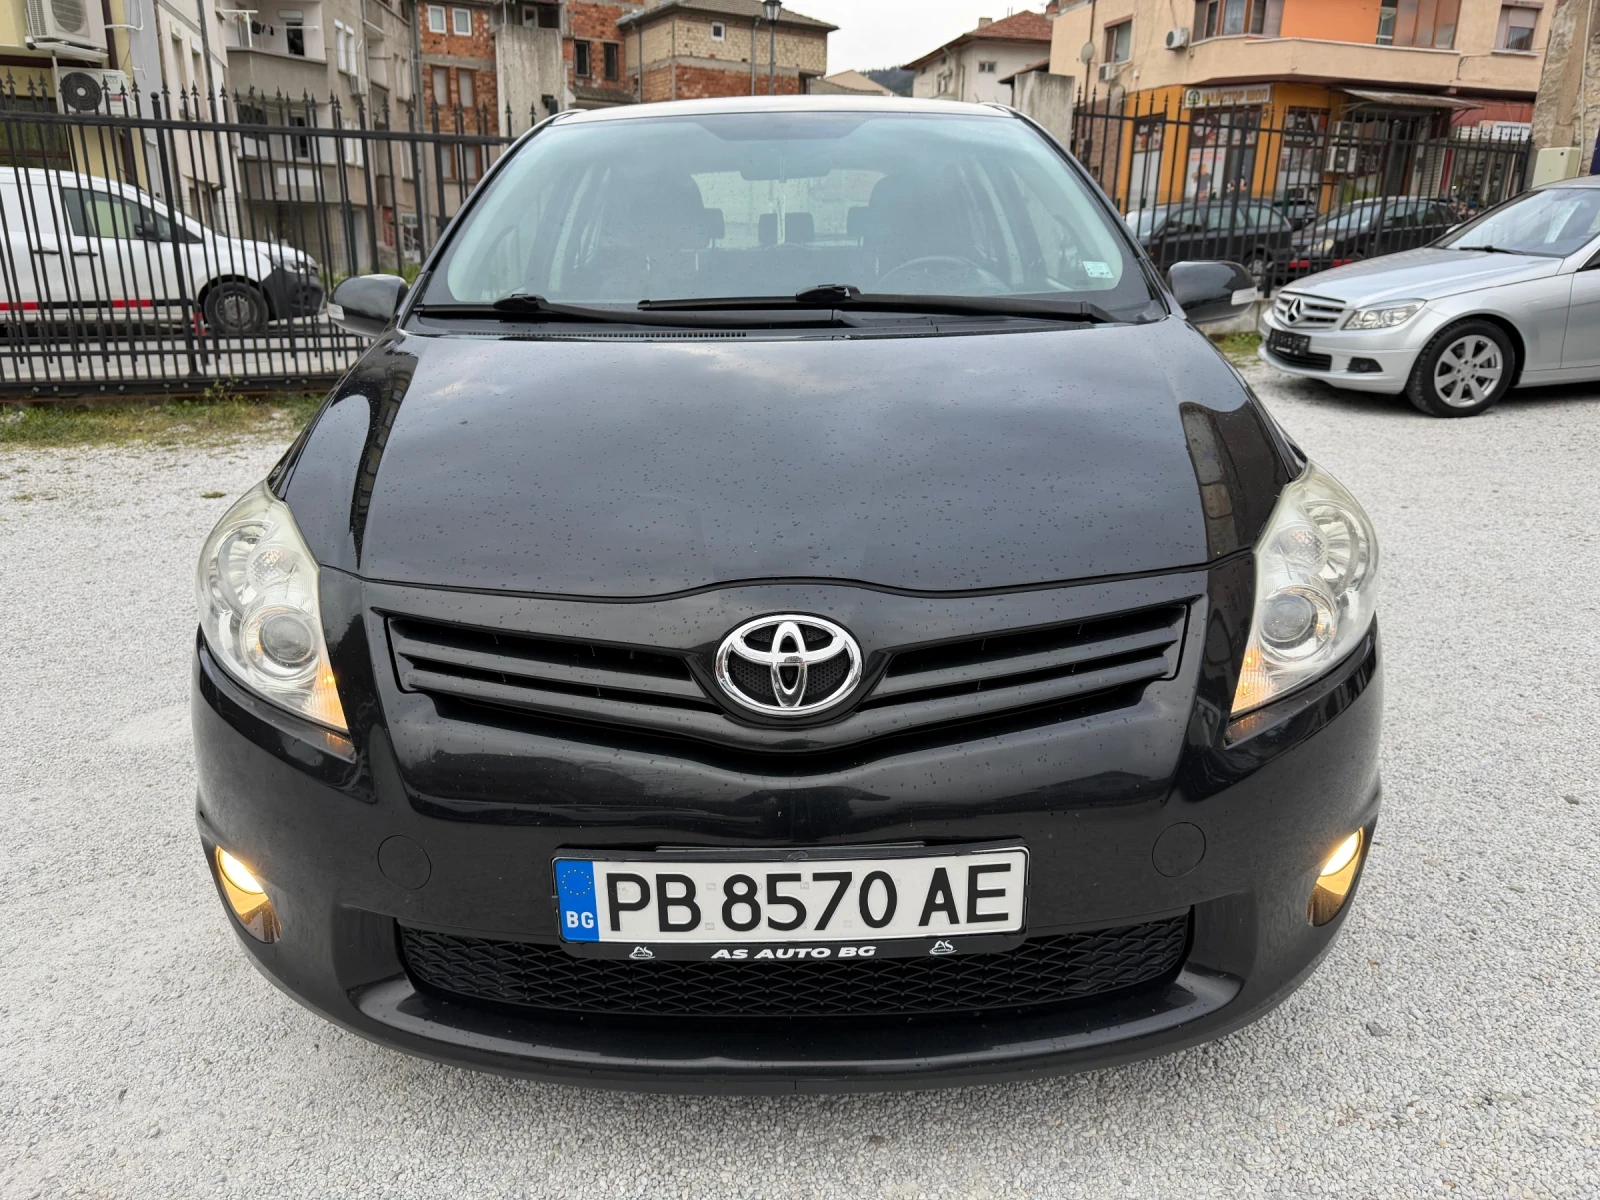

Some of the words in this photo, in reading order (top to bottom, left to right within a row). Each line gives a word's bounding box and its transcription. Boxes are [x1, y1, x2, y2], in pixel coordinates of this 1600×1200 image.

[606, 872, 701, 932] PB
[721, 870, 897, 932] 8570
[918, 862, 1012, 926] AE
[566, 911, 595, 929] BG
[711, 949, 748, 959] AS
[754, 947, 831, 959] AUTO
[838, 945, 877, 957] BG
